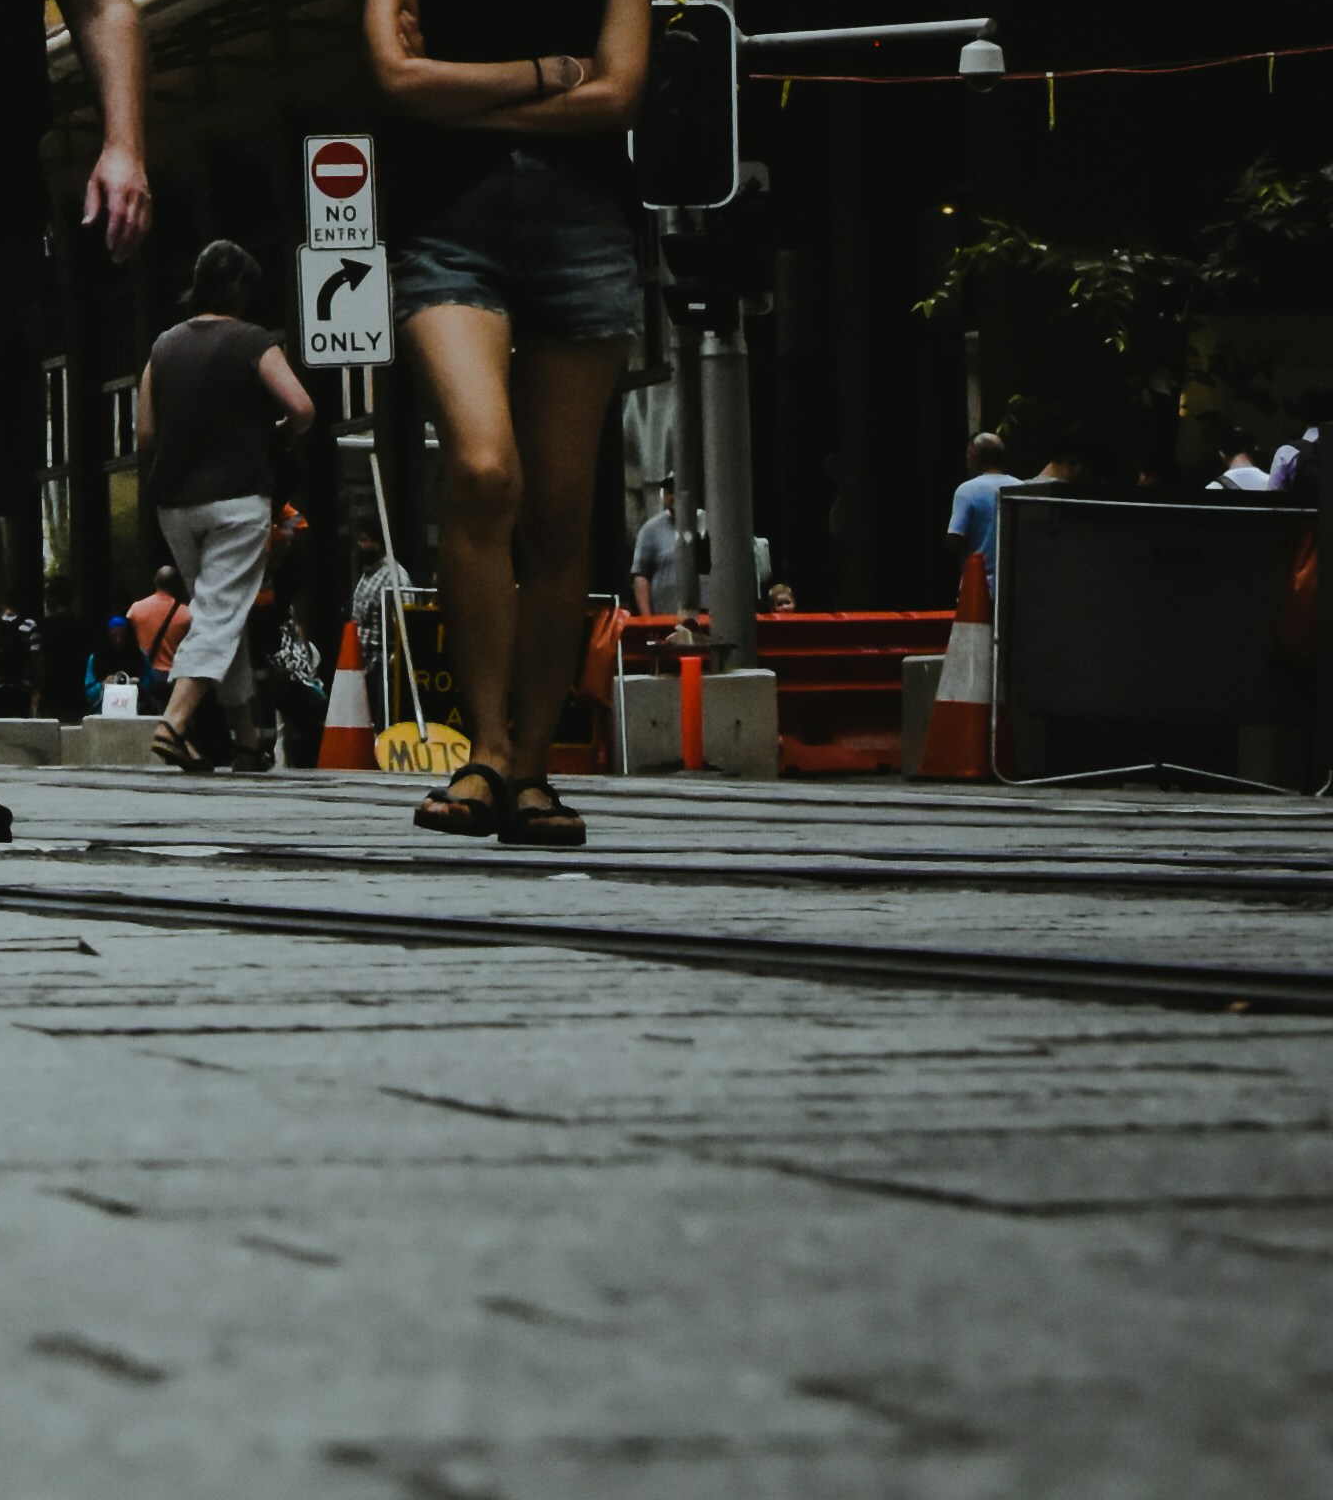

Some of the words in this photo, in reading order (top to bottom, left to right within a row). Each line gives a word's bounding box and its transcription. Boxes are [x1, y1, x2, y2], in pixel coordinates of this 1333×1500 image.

[326, 205, 357, 222] NO
[314, 227, 368, 242] ENTRY
[310, 330, 382, 353] ONLY
